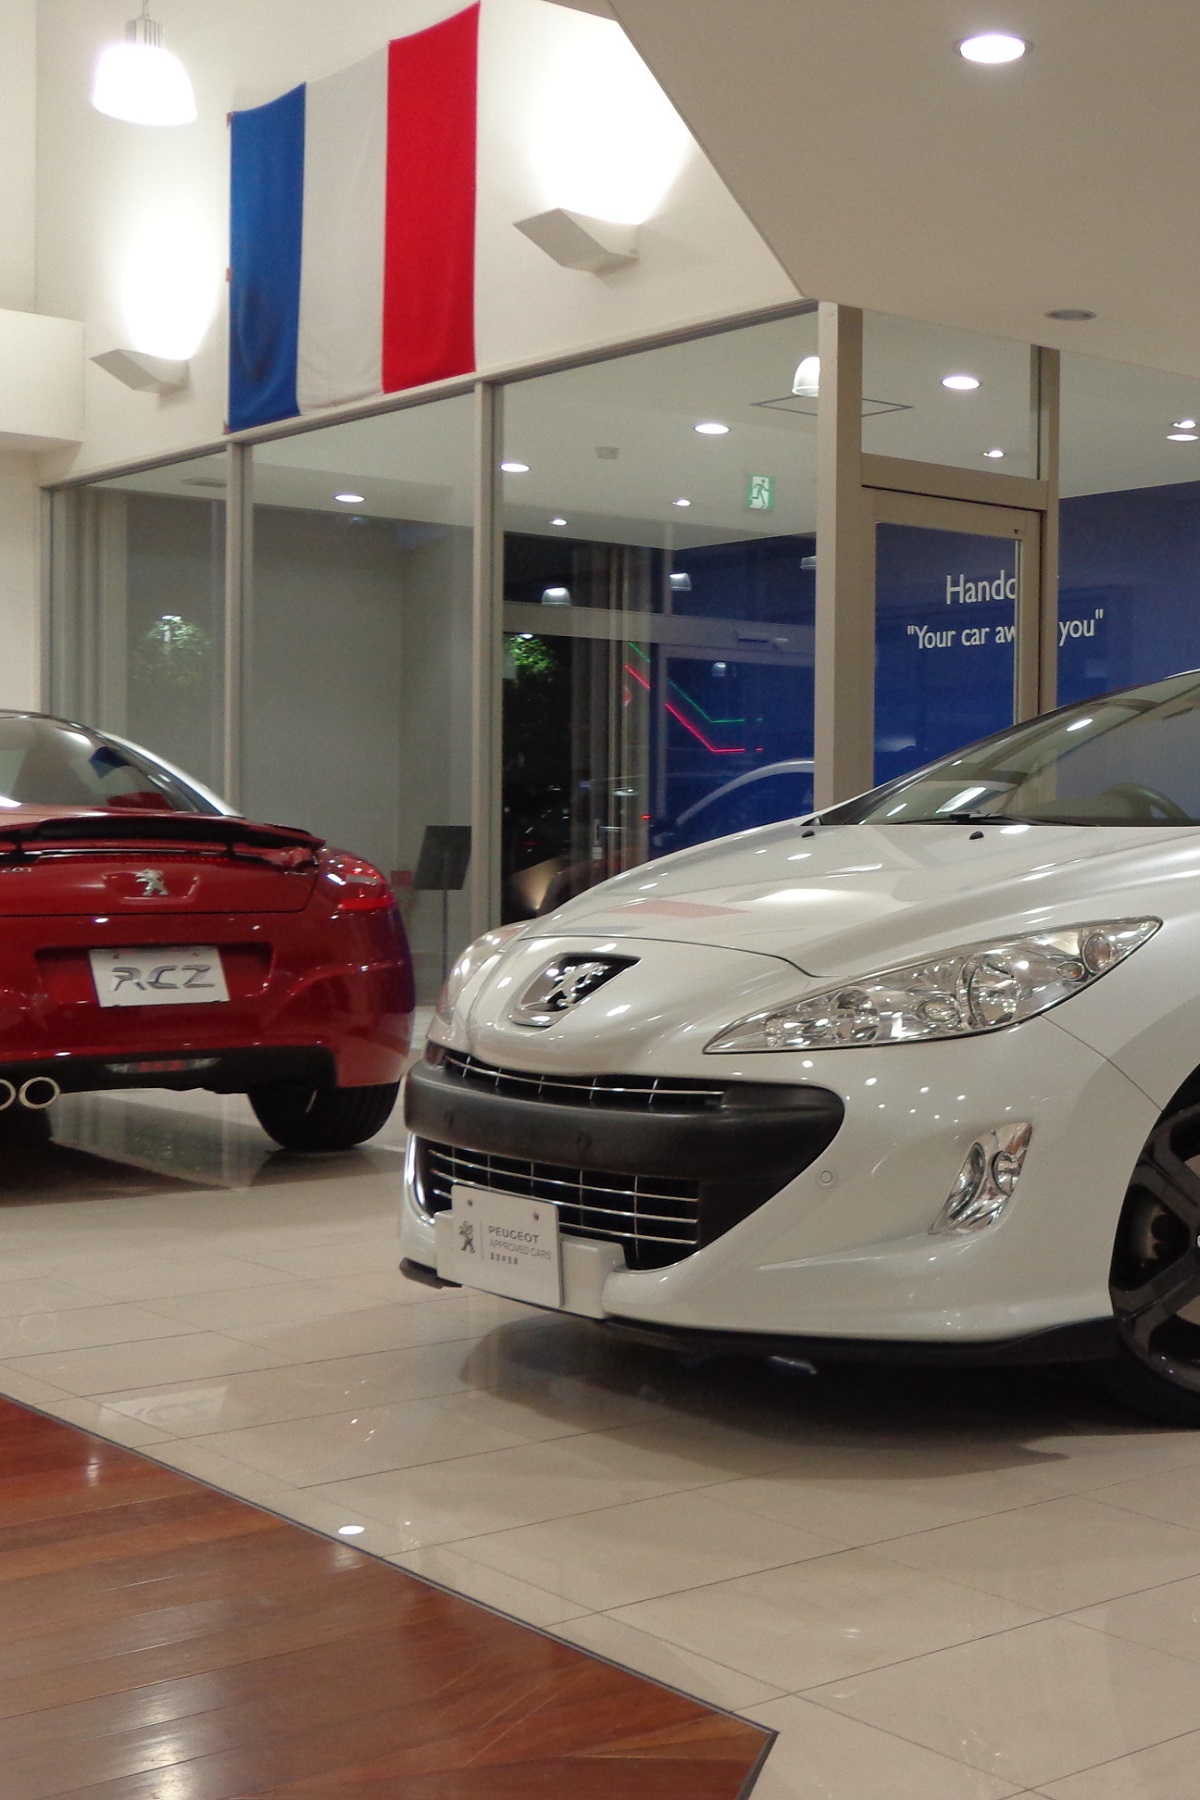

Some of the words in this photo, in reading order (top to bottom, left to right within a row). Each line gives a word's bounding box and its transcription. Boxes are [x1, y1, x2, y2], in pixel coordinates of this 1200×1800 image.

[946, 569, 1016, 604] Hando
[907, 624, 956, 649] "Your
[961, 627, 990, 645] car
[1058, 608, 1104, 647] you"
[112, 964, 215, 992] RCZ
[488, 1225, 539, 1243] PEUGEOT
